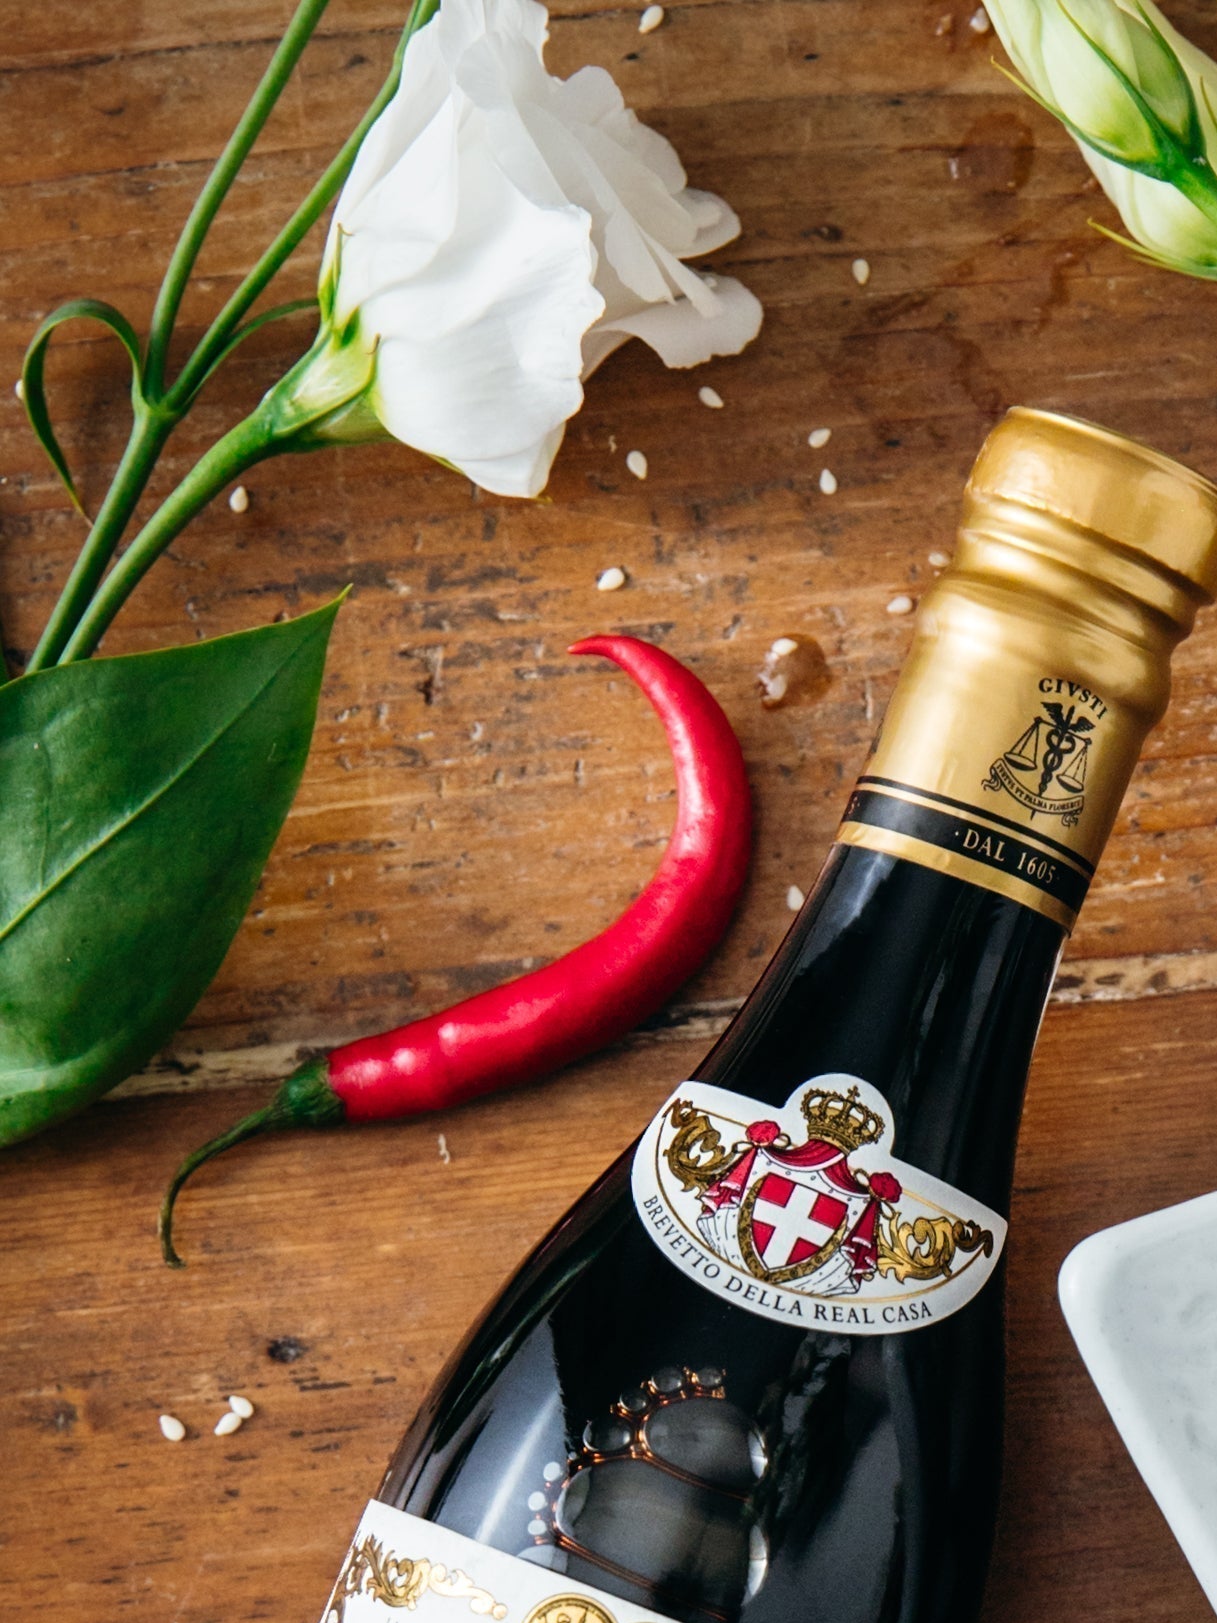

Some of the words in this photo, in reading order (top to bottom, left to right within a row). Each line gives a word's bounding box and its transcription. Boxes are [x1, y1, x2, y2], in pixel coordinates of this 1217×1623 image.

[1038, 677, 1108, 720] GIVSTI
[963, 828, 1006, 862] DAL
[1016, 851, 1057, 884] 1605
[643, 1195, 720, 1278] BREVETTO
[724, 1275, 803, 1317] DELLA
[814, 1304, 875, 1324] REAL
[882, 1301, 933, 1324] CASA
